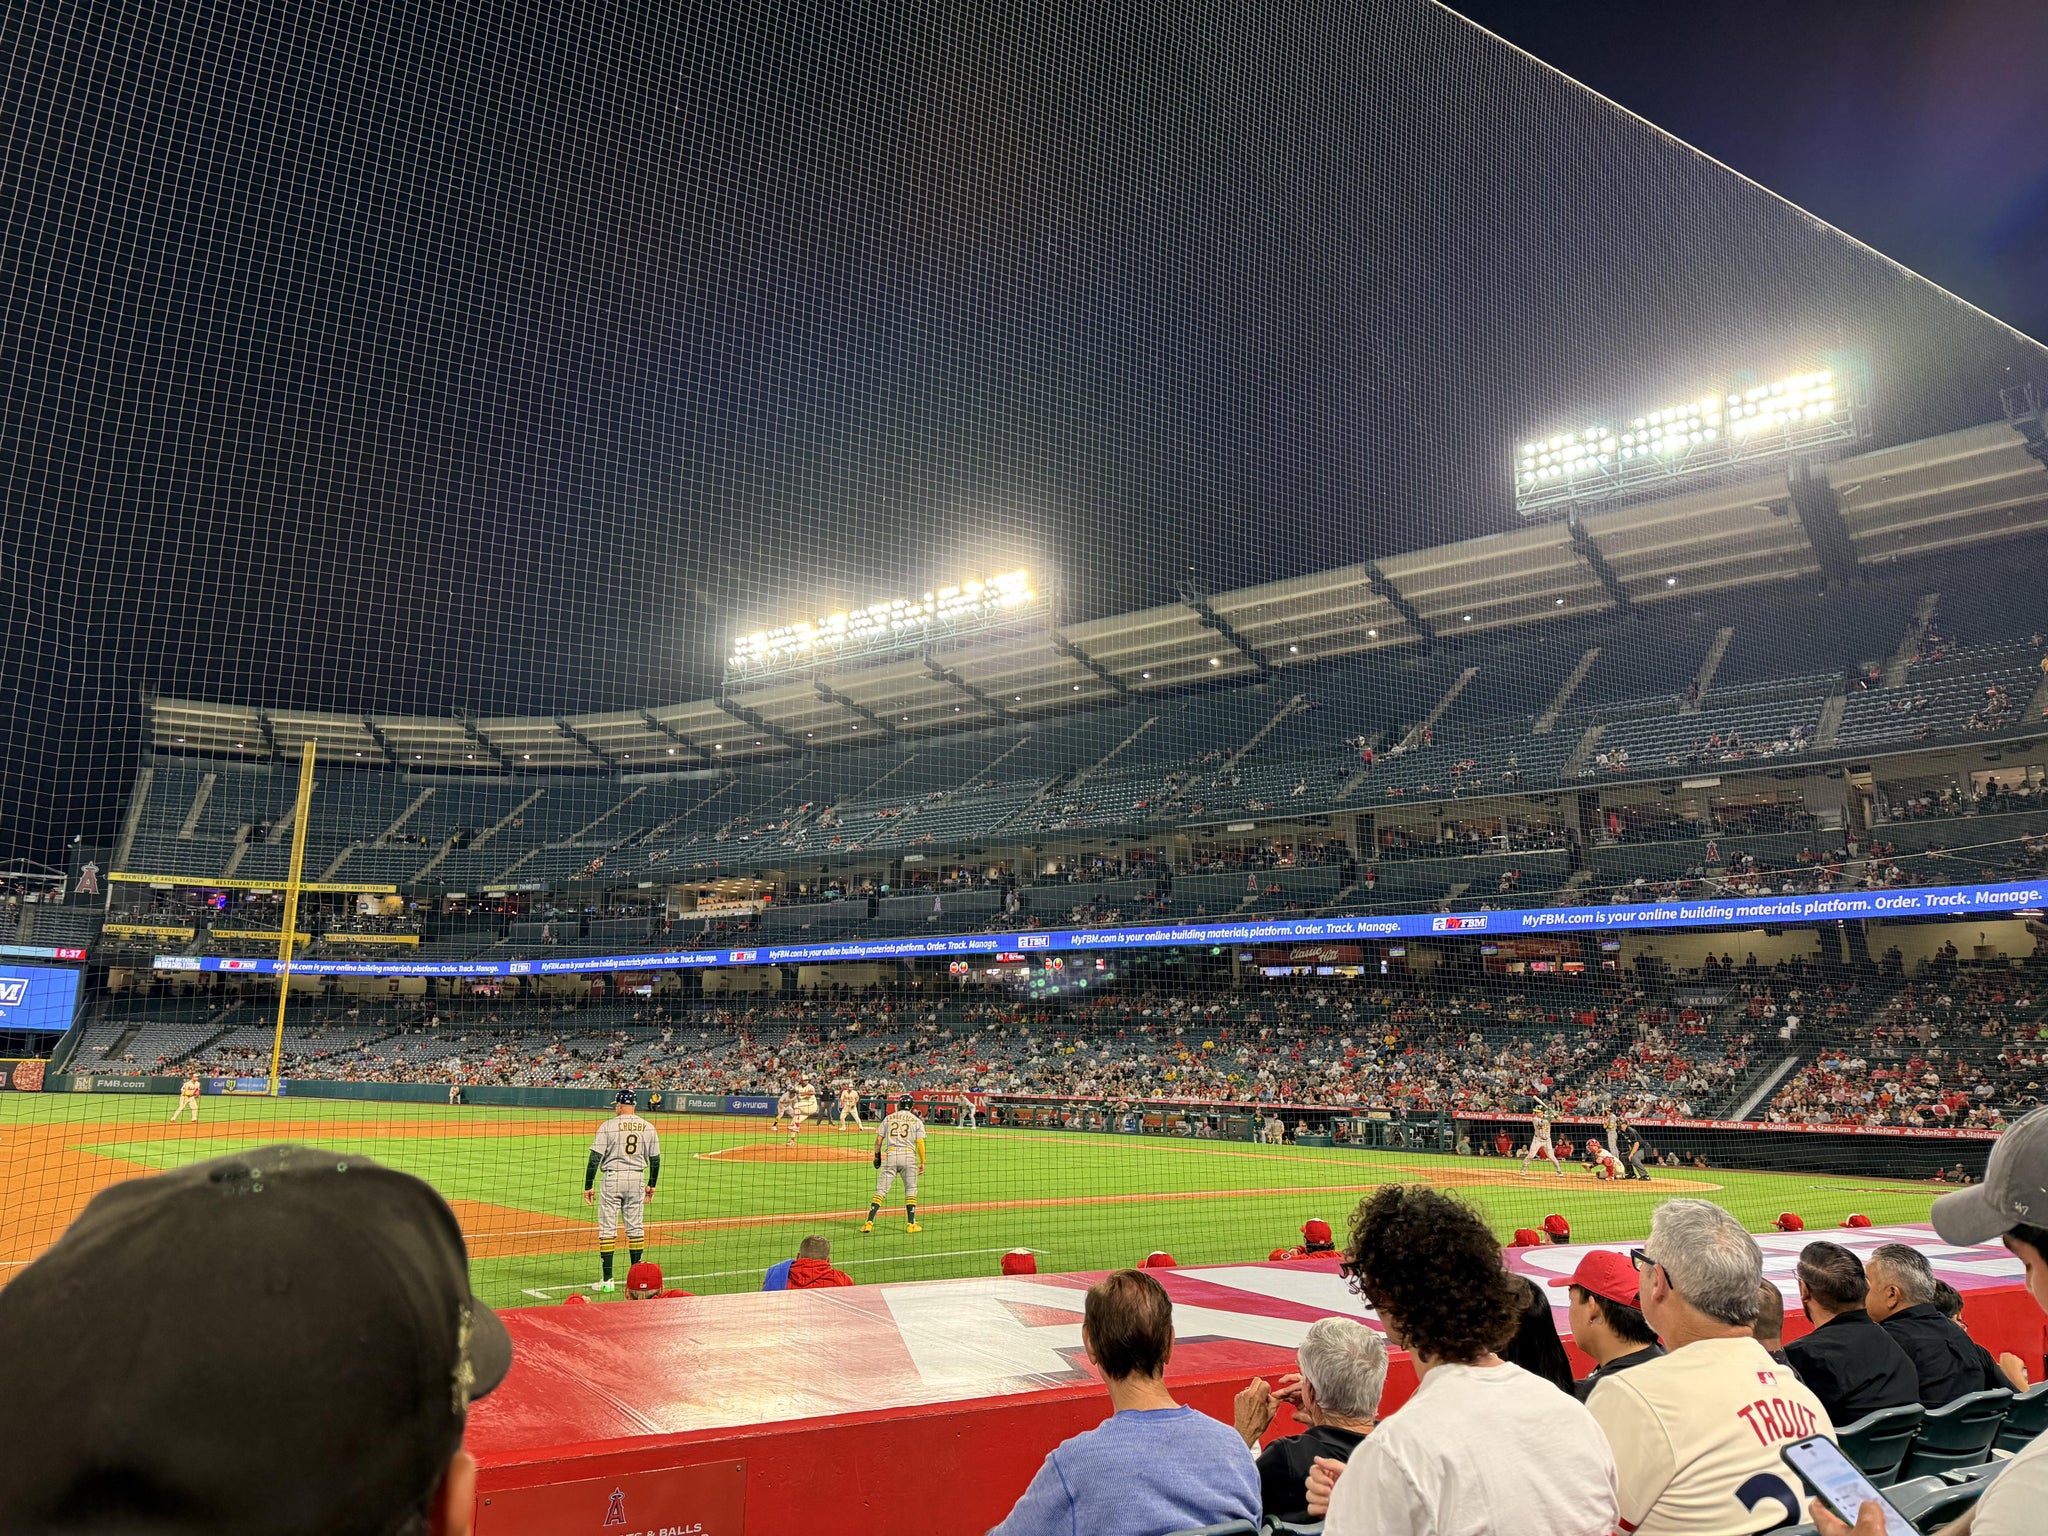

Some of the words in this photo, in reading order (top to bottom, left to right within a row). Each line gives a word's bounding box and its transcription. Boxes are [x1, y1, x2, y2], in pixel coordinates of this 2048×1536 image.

[216, 880, 253, 888] RESTAURANT
[1522, 913, 1594, 928] MyFBM.com
[1595, 911, 1606, 924] is
[1607, 912, 1637, 927] your
[1638, 907, 1679, 922] online
[1680, 904, 1734, 920] building
[1736, 901, 1803, 918] materials
[1803, 898, 1872, 916] platform.
[1874, 895, 1922, 909] Order.
[1923, 892, 1972, 908] Track.
[1975, 888, 2044, 906] Manage.
[1071, 934, 1117, 946] MyFBM.com
[1117, 932, 1125, 943] is
[1124, 934, 1144, 945] your
[1145, 931, 1171, 942] online
[1171, 929, 1206, 941] building
[1207, 926, 1249, 939] materials
[1249, 923, 1293, 939] platform.
[1294, 923, 1325, 935] Order.
[1326, 923, 1356, 935] Track.
[1357, 921, 1402, 936] Manage.
[60, 949, 81, 958] 8:37
[769, 949, 803, 960] MyFBM.com
[807, 949, 822, 959] your
[822, 947, 841, 956] online
[841, 945, 866, 956] building
[866, 944, 896, 955] materials
[895, 942, 926, 954] platform.
[926, 941, 947, 950] Order.
[948, 941, 968, 950] Track.
[968, 939, 998, 950] Manage.
[1290, 947, 1322, 960] Classic
[319, 965, 336, 974] your
[336, 964, 357, 972] online
[357, 964, 382, 974] building
[383, 965, 412, 973] materials
[97, 1079, 146, 1088] FMB.com
[226, 1079, 237, 1088] 811
[688, 1099, 717, 1108] FMB.com
[742, 1101, 769, 1109] HYUNDAI
[1465, 1112, 1478, 1120] State
[1478, 1112, 1493, 1120] Farm
[618, 1121, 647, 1131] CROSBY
[889, 1121, 910, 1139] 23
[1720, 1121, 1737, 1129] State
[1736, 1122, 1753, 1130] Farm
[1767, 1123, 1785, 1131] State
[1816, 1125, 1833, 1133] State
[1865, 1127, 1883, 1135] State
[1882, 1127, 1900, 1135] Farm
[1914, 1128, 1933, 1136] State
[1966, 1130, 1984, 1138] State
[1983, 1131, 2001, 1140] Farm
[624, 1133, 639, 1156] 8
[1737, 1398, 1817, 1447] TROUT
